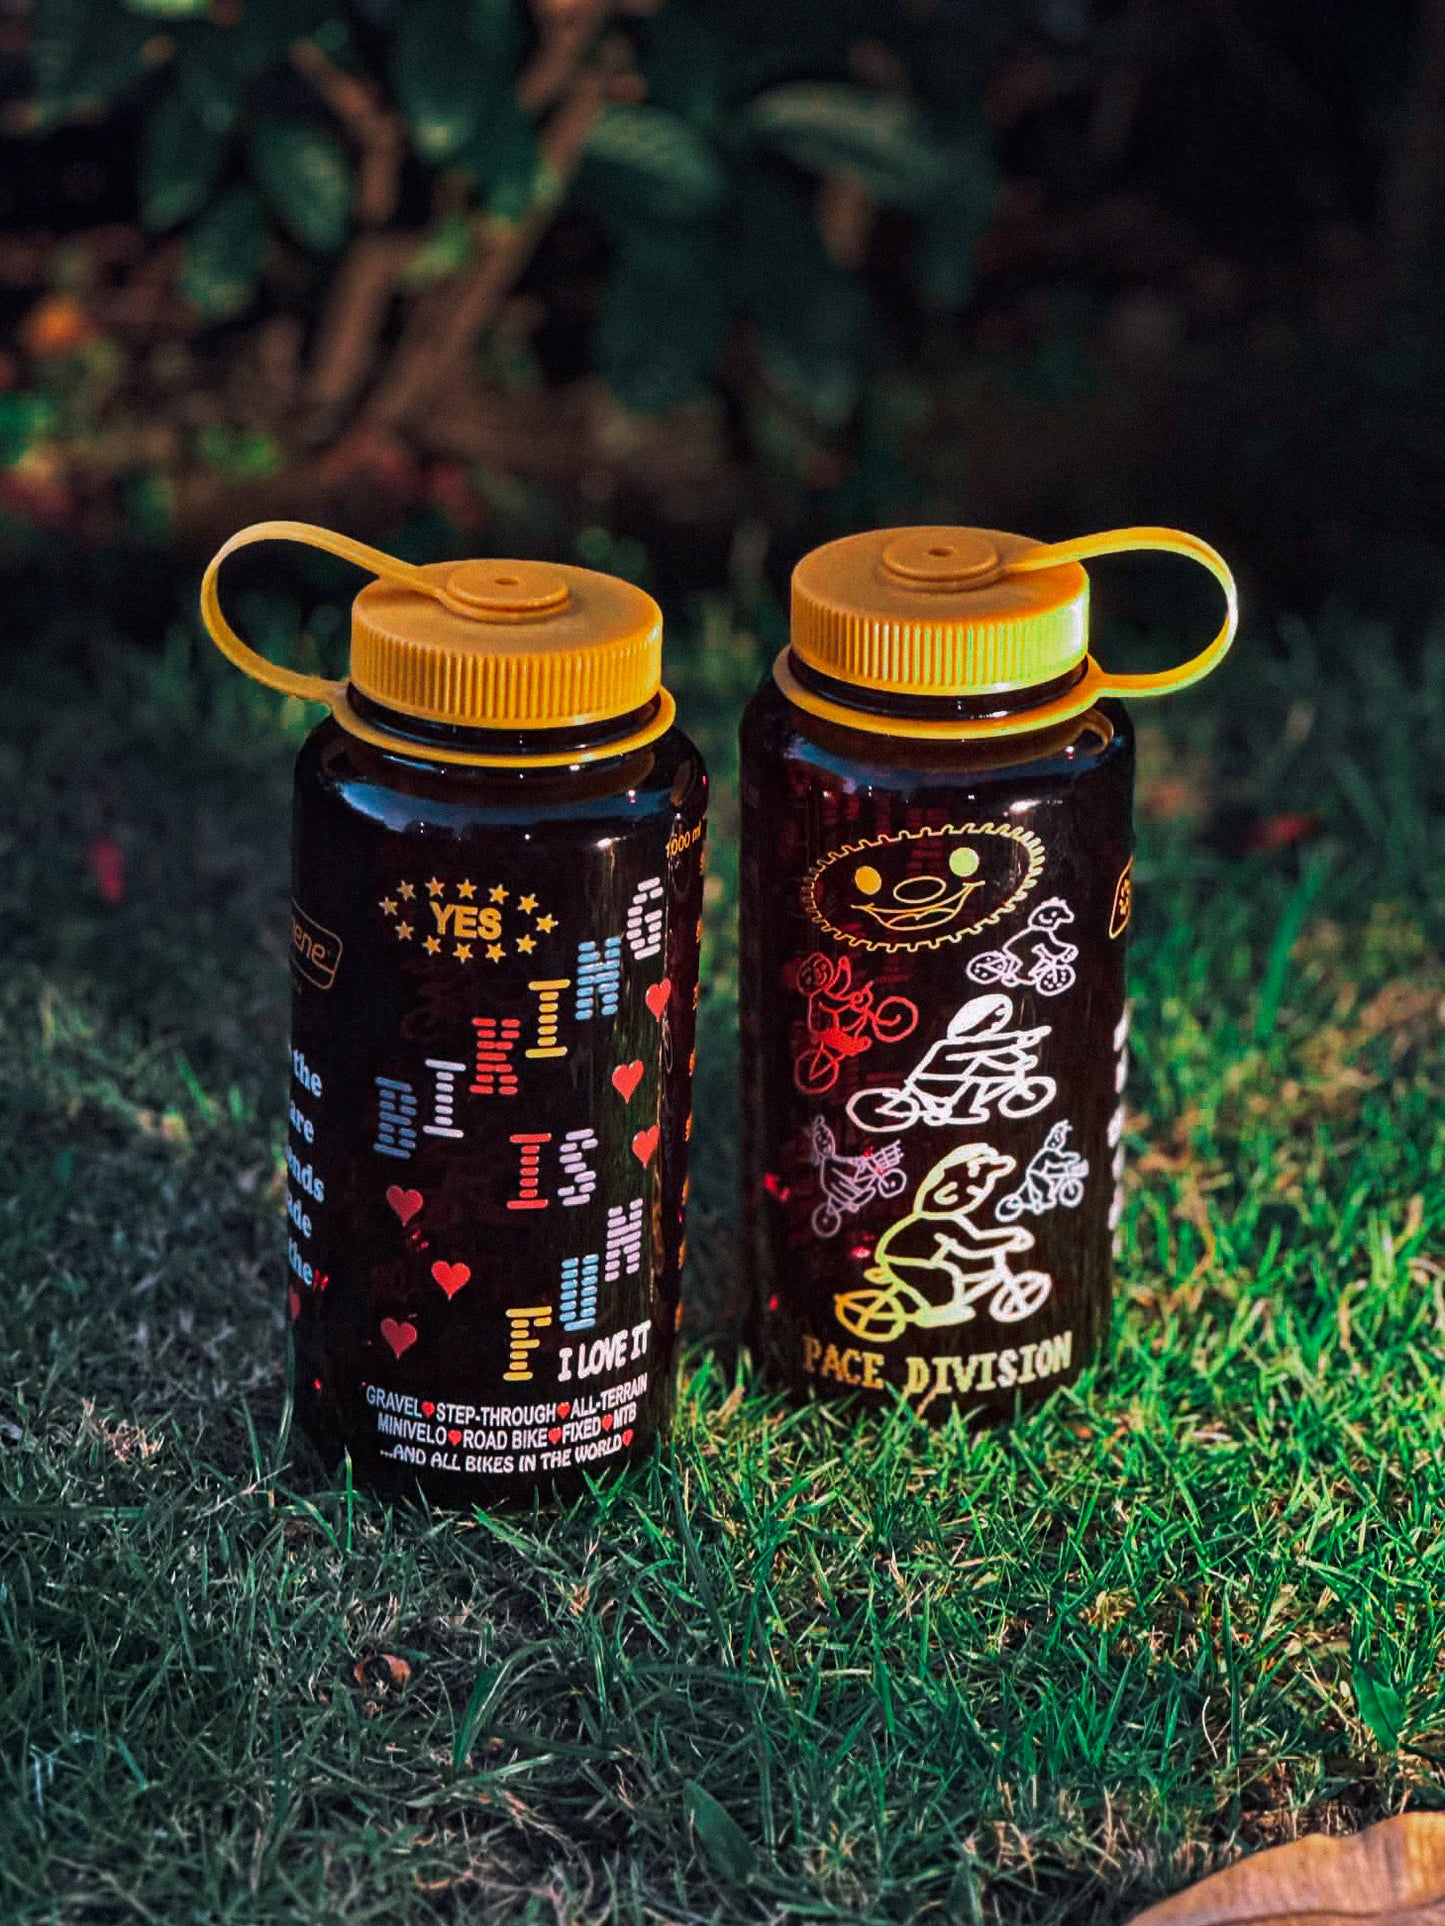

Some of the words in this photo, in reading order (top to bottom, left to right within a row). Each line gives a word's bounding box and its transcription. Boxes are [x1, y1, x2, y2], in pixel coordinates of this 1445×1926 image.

[665, 831, 691, 858] 1000
[292, 918, 327, 968] ene
[430, 902, 503, 940] YES
[293, 1049, 323, 1097] the
[506, 1128, 598, 1209] IS
[503, 1198, 643, 1381] FUN
[557, 1347, 573, 1382] I
[577, 1329, 629, 1379] LOVE
[630, 1319, 652, 1361] IT
[802, 1335, 885, 1390] PACE
[905, 1331, 1073, 1394] DIVISION
[366, 1384, 422, 1419] GRAVEL
[436, 1402, 556, 1427] STEP-THROUGH
[569, 1372, 648, 1420] ALL-TERRAIN
[378, 1412, 447, 1445] MINIVELO
[463, 1429, 508, 1450] ROAD
[512, 1428, 549, 1450] BIKE
[562, 1417, 601, 1444] FIXED
[613, 1401, 637, 1430] MTB
[431, 1452, 461, 1471] ALL
[465, 1455, 515, 1474] BIKES
[518, 1454, 537, 1473] IN
[540, 1449, 571, 1470] THE
[574, 1433, 622, 1463] WORLD
